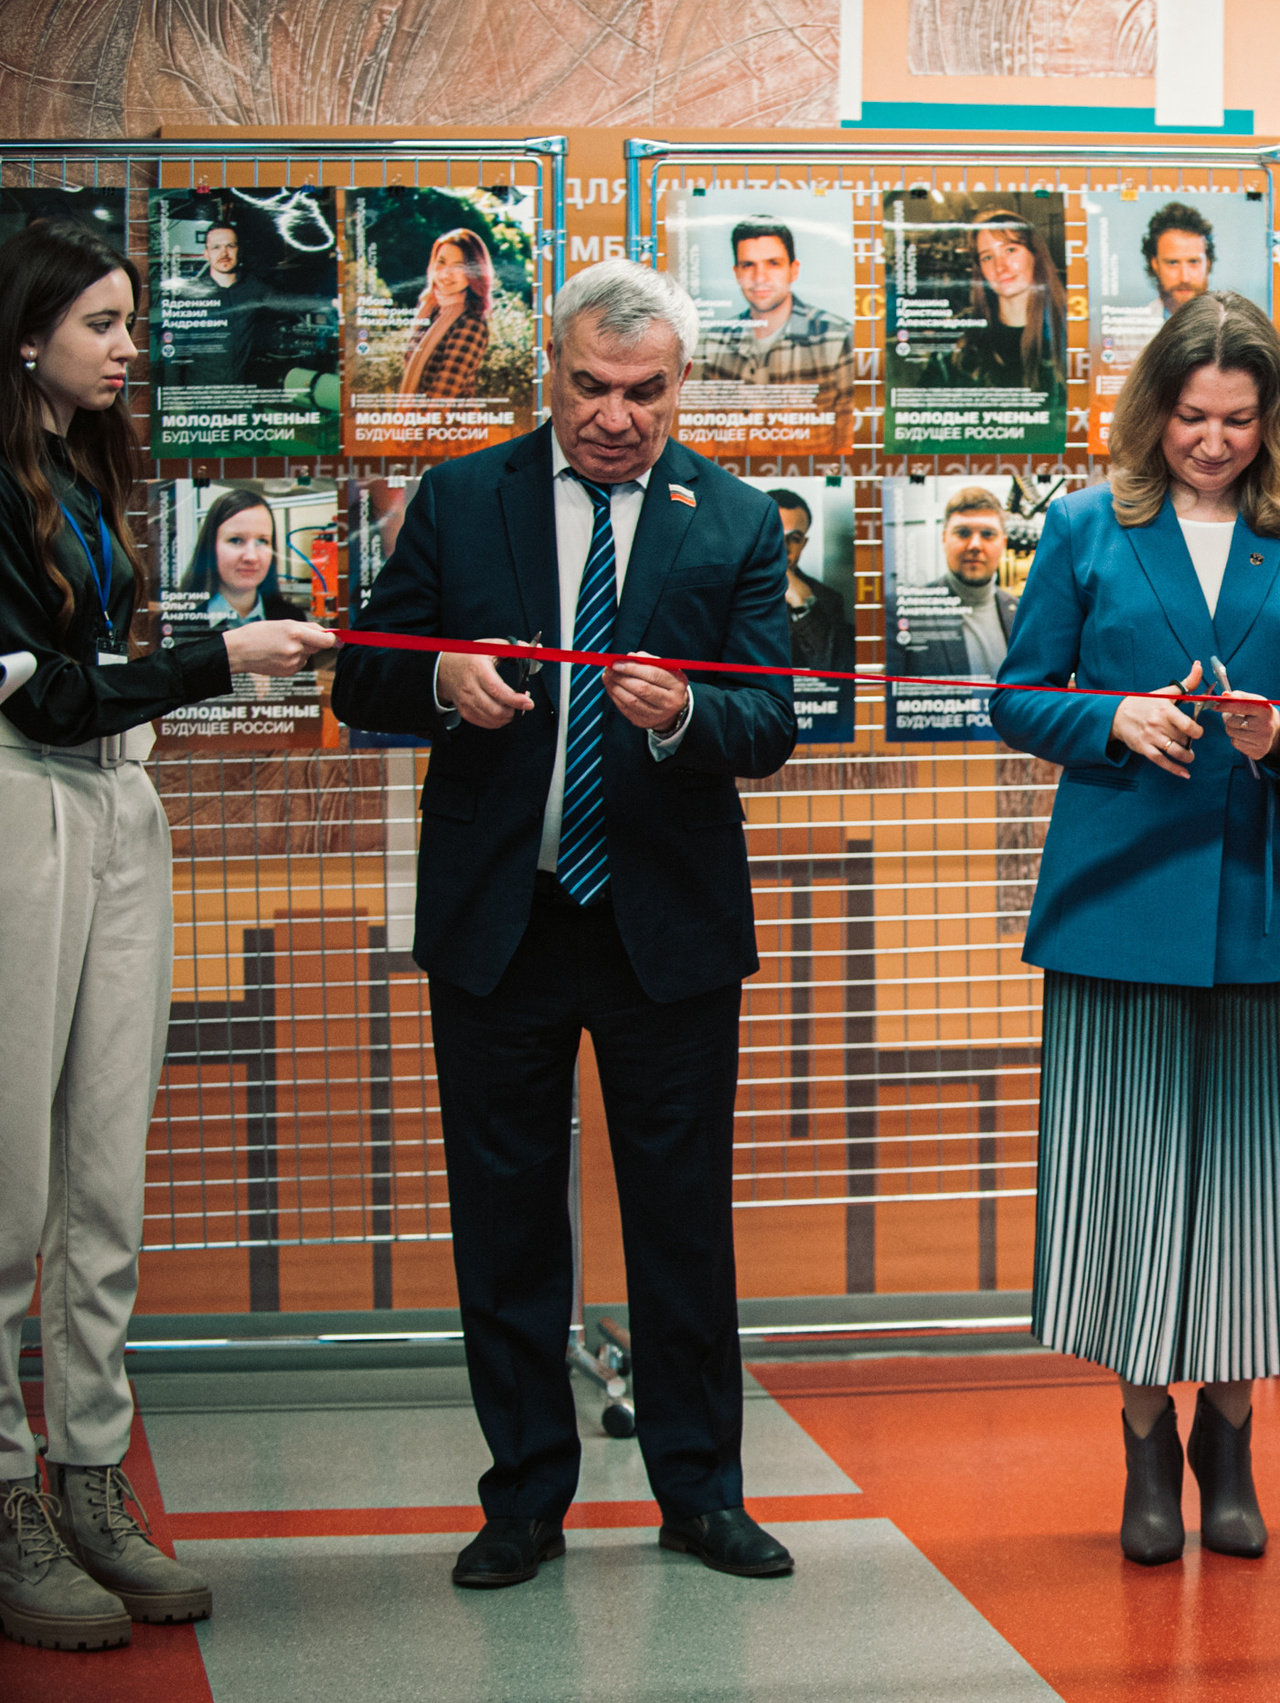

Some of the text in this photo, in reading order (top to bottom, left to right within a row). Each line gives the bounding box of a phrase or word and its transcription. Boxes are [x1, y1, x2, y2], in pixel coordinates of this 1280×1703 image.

[565, 178, 627, 211] ДЛЯ
[161, 299, 221, 310] Ядренкин
[896, 297, 950, 309] Гришина
[161, 309, 208, 318] Михаил
[356, 306, 421, 317] Екатерина
[896, 309, 953, 318] Кристина
[161, 319, 228, 329] Андреевич
[356, 316, 431, 326] Михайловна
[896, 317, 988, 329] Александровна
[162, 412, 320, 428] МОЛОДЫЕ УЧЕНЫЕ
[355, 412, 514, 425] МОЛОДЫЕ УЧЕНЫЕ
[678, 412, 836, 427] МОЛОДЫЕ УЧЕНЫЕ
[895, 412, 980, 426] МОЛОДЫЕ
[982, 411, 1050, 424] УЧЕНЫЕ
[162, 429, 295, 445] БУДУЩЕЕ РОССИИ
[355, 427, 488, 443] БУДУЩЕЕ РОССИИ
[678, 428, 810, 443] БУДУЩЕЕ РОССИИ
[895, 427, 1025, 442] БУДУЩЕЕ РОССИИ
[161, 590, 210, 601] Брагина
[161, 601, 196, 610] Ольга
[161, 611, 237, 621] Анатольевна
[162, 705, 320, 720] МОЛОДЫЕ УЧЕНЫЕ
[896, 699, 981, 714] МОЛОДЫЕ
[161, 721, 294, 736] БУДУЩЕЕ РОССИИ
[896, 714, 964, 729] БУДУЩЕЕ
